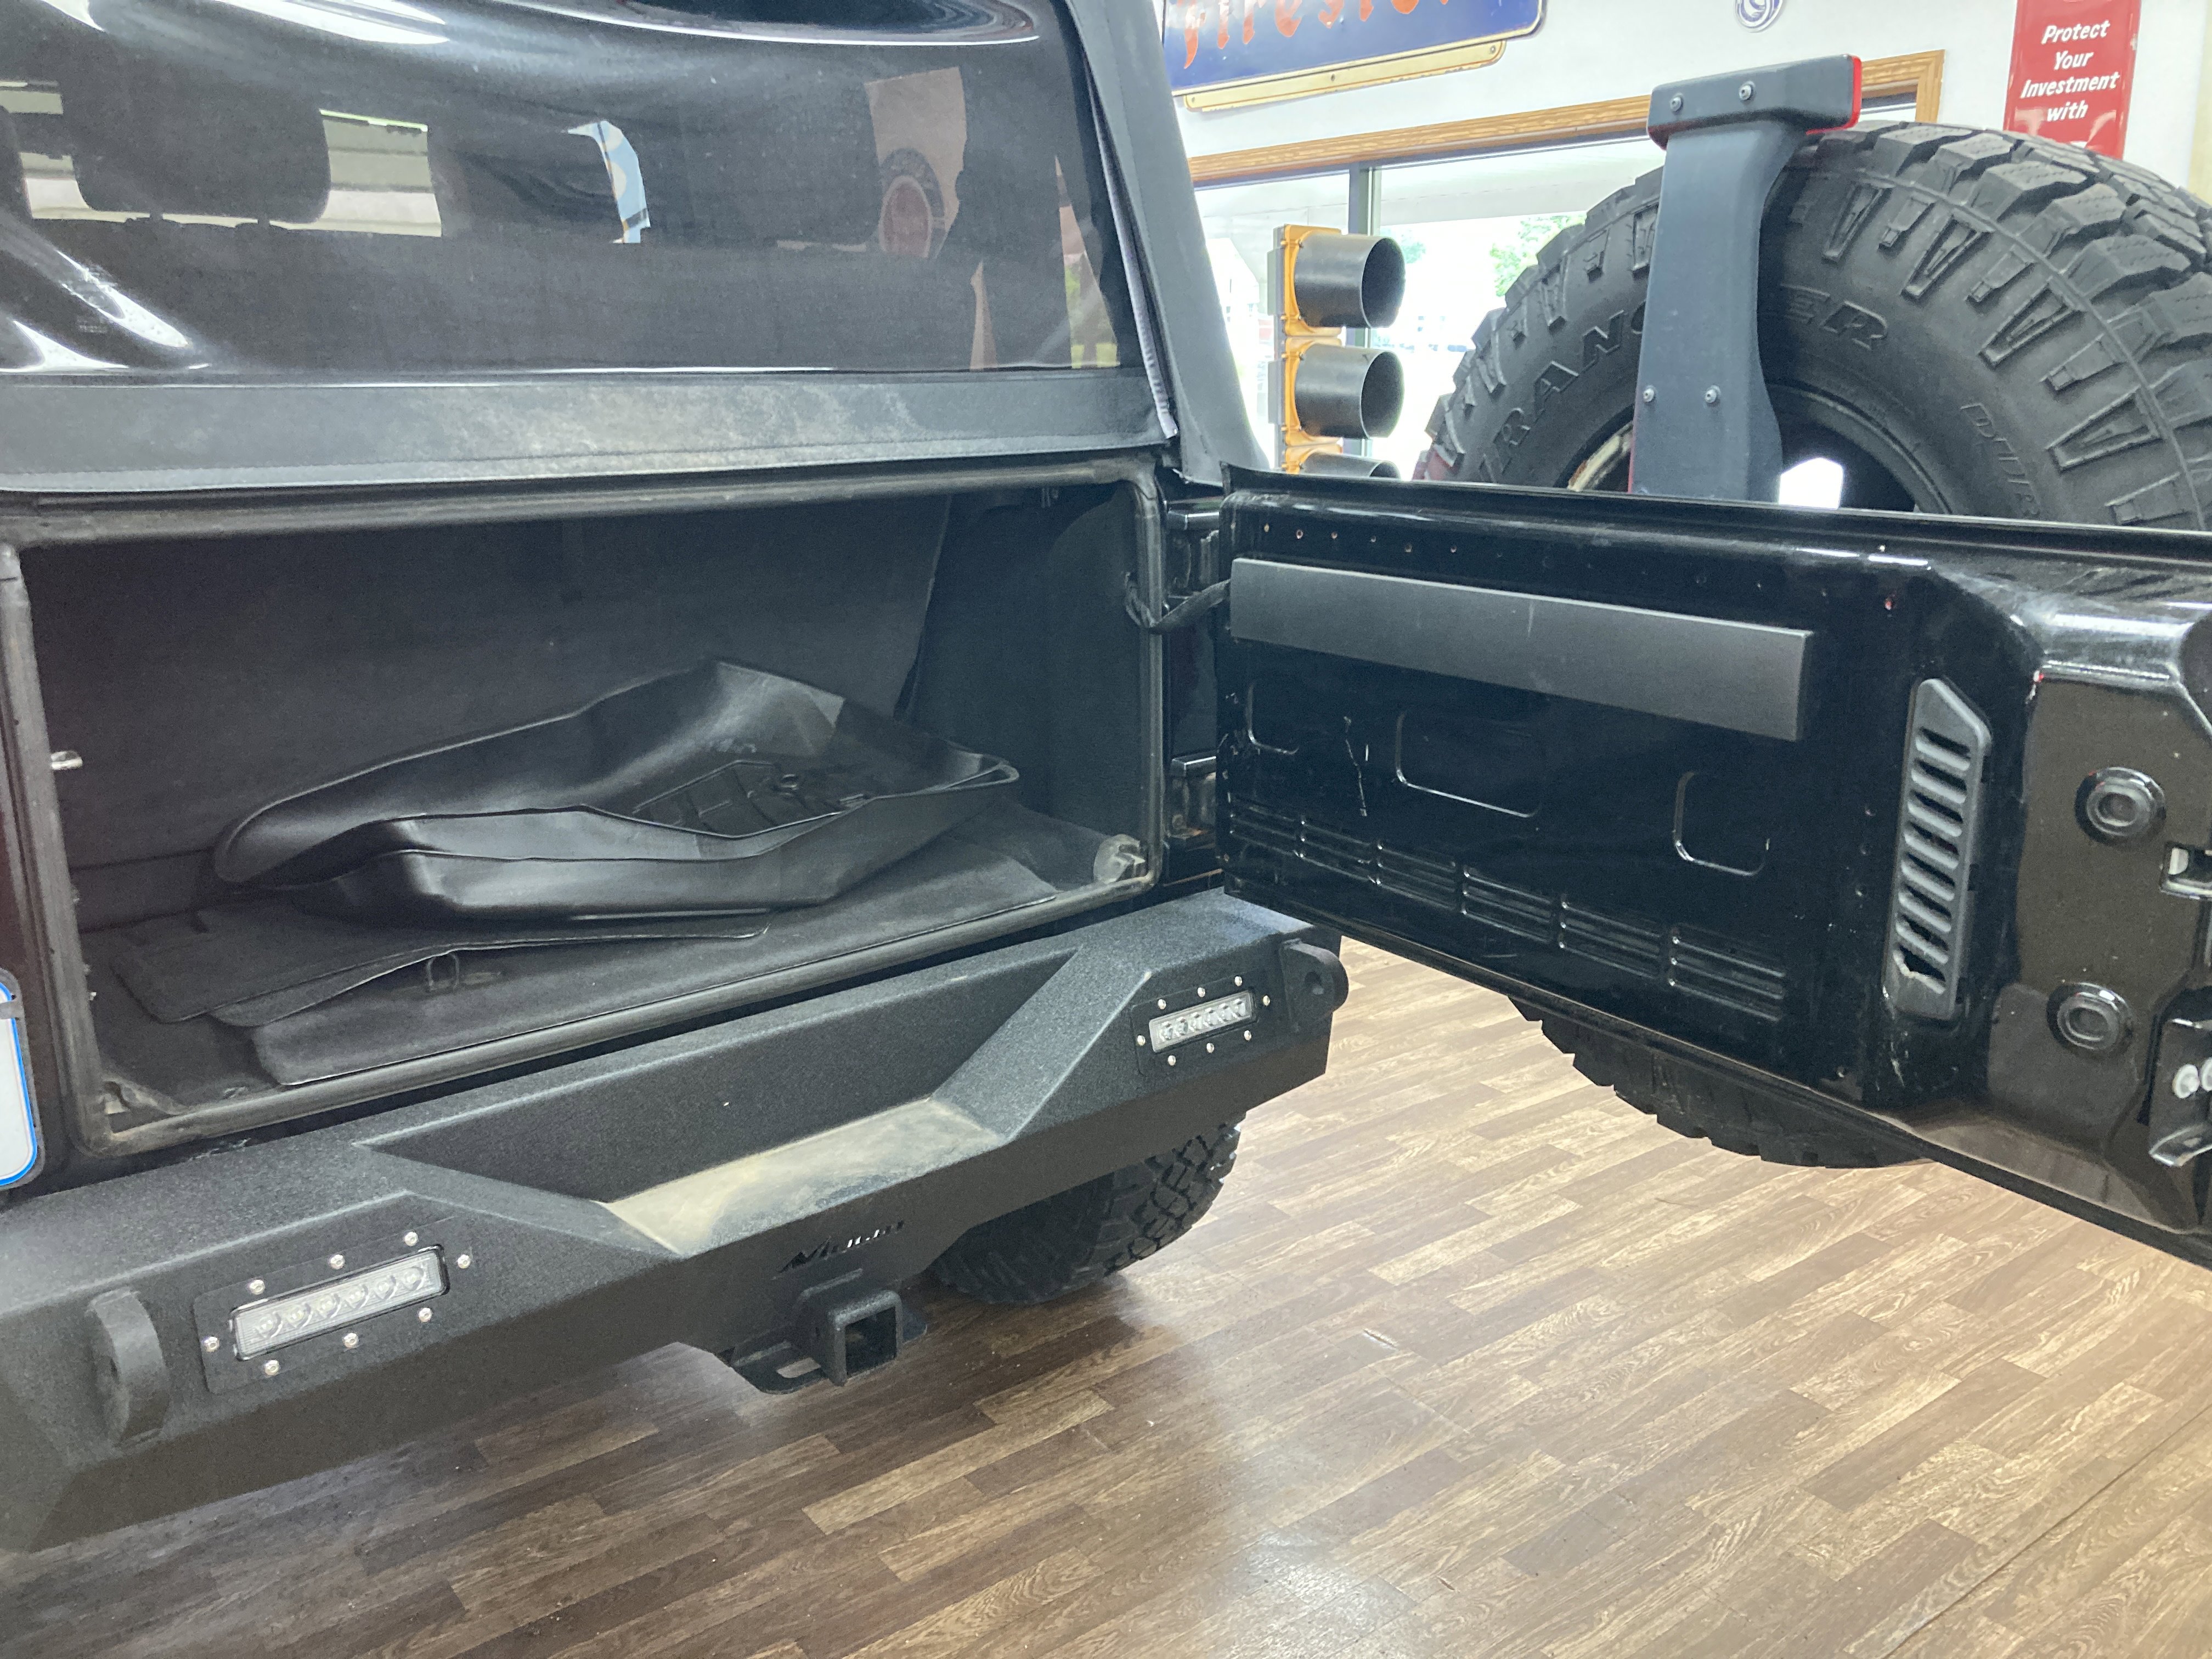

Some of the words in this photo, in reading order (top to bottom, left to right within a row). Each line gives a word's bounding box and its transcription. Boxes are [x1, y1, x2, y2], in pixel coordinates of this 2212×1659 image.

[2041, 20, 2111, 44] Protect
[2053, 50, 2094, 70] Your
[2020, 71, 2120, 99] Investment
[2046, 100, 2089, 122] with
